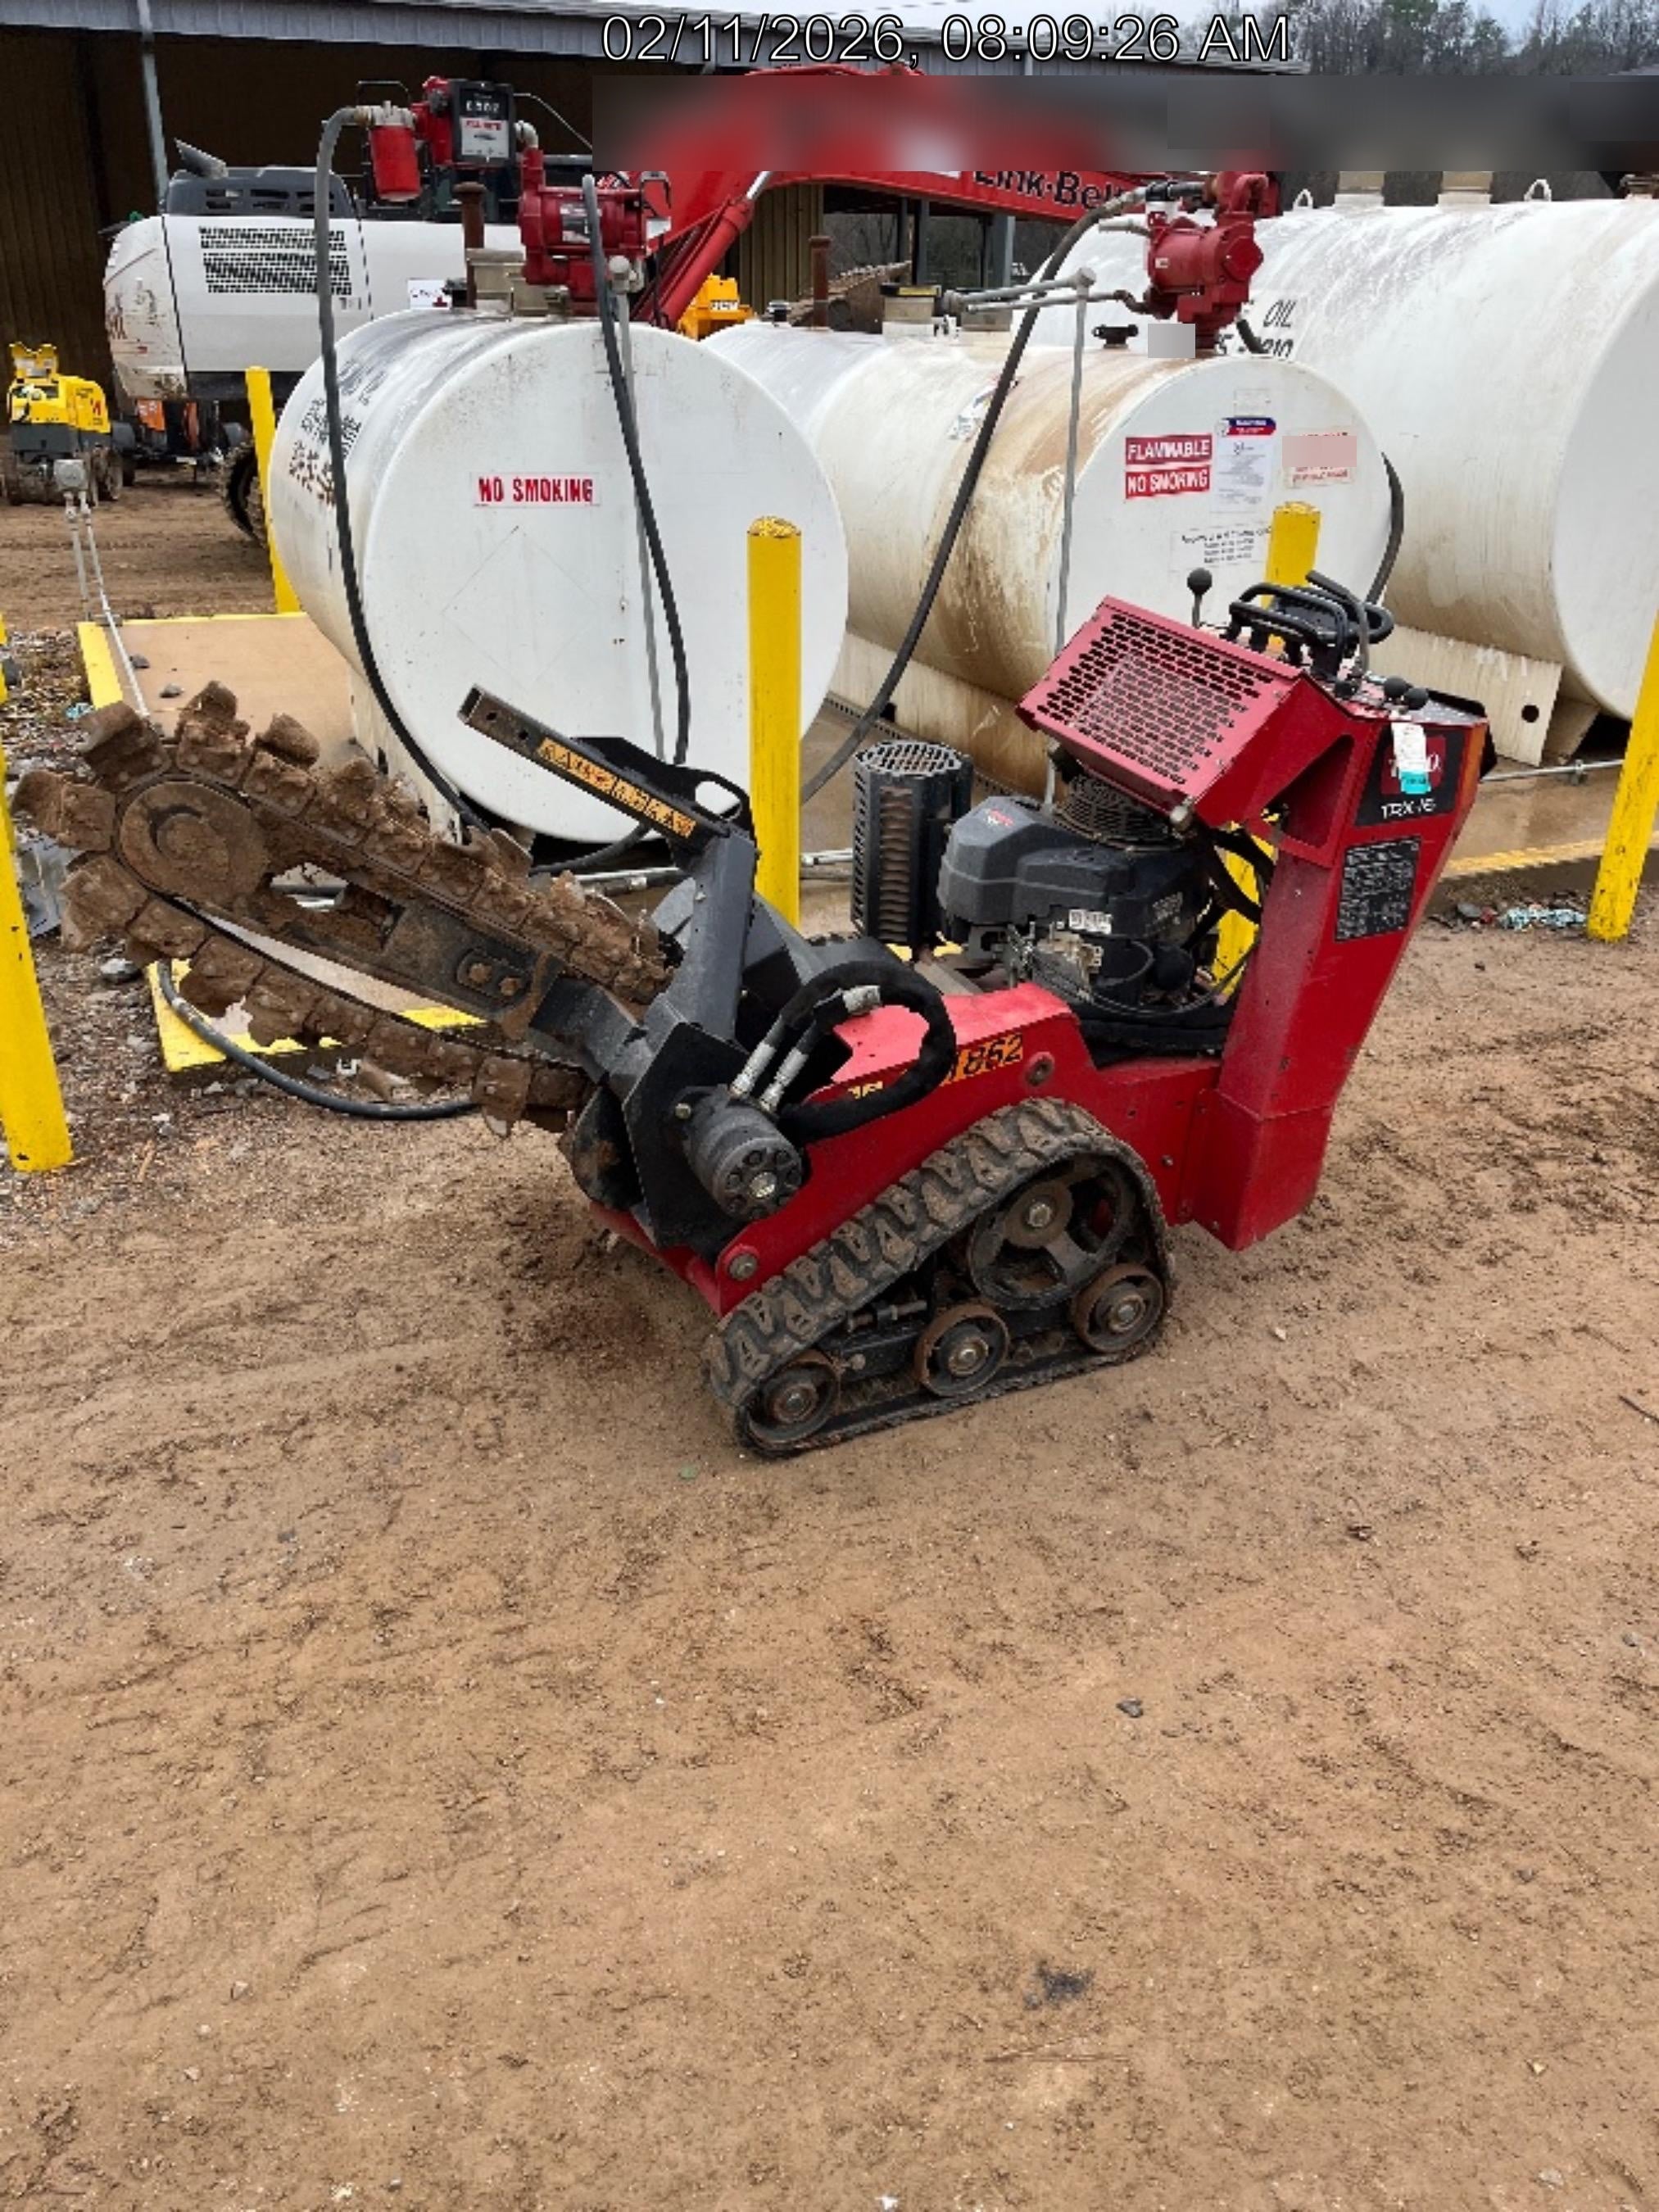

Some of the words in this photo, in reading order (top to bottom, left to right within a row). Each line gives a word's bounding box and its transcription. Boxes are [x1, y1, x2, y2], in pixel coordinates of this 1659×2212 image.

[1262, 299, 1296, 327] OIL
[1127, 439, 1210, 460] FLAMMABLE
[478, 476, 504, 502] NO
[513, 476, 593, 502] SMOKING
[1127, 474, 1146, 495] NO
[1149, 469, 1208, 492] SMOKING
